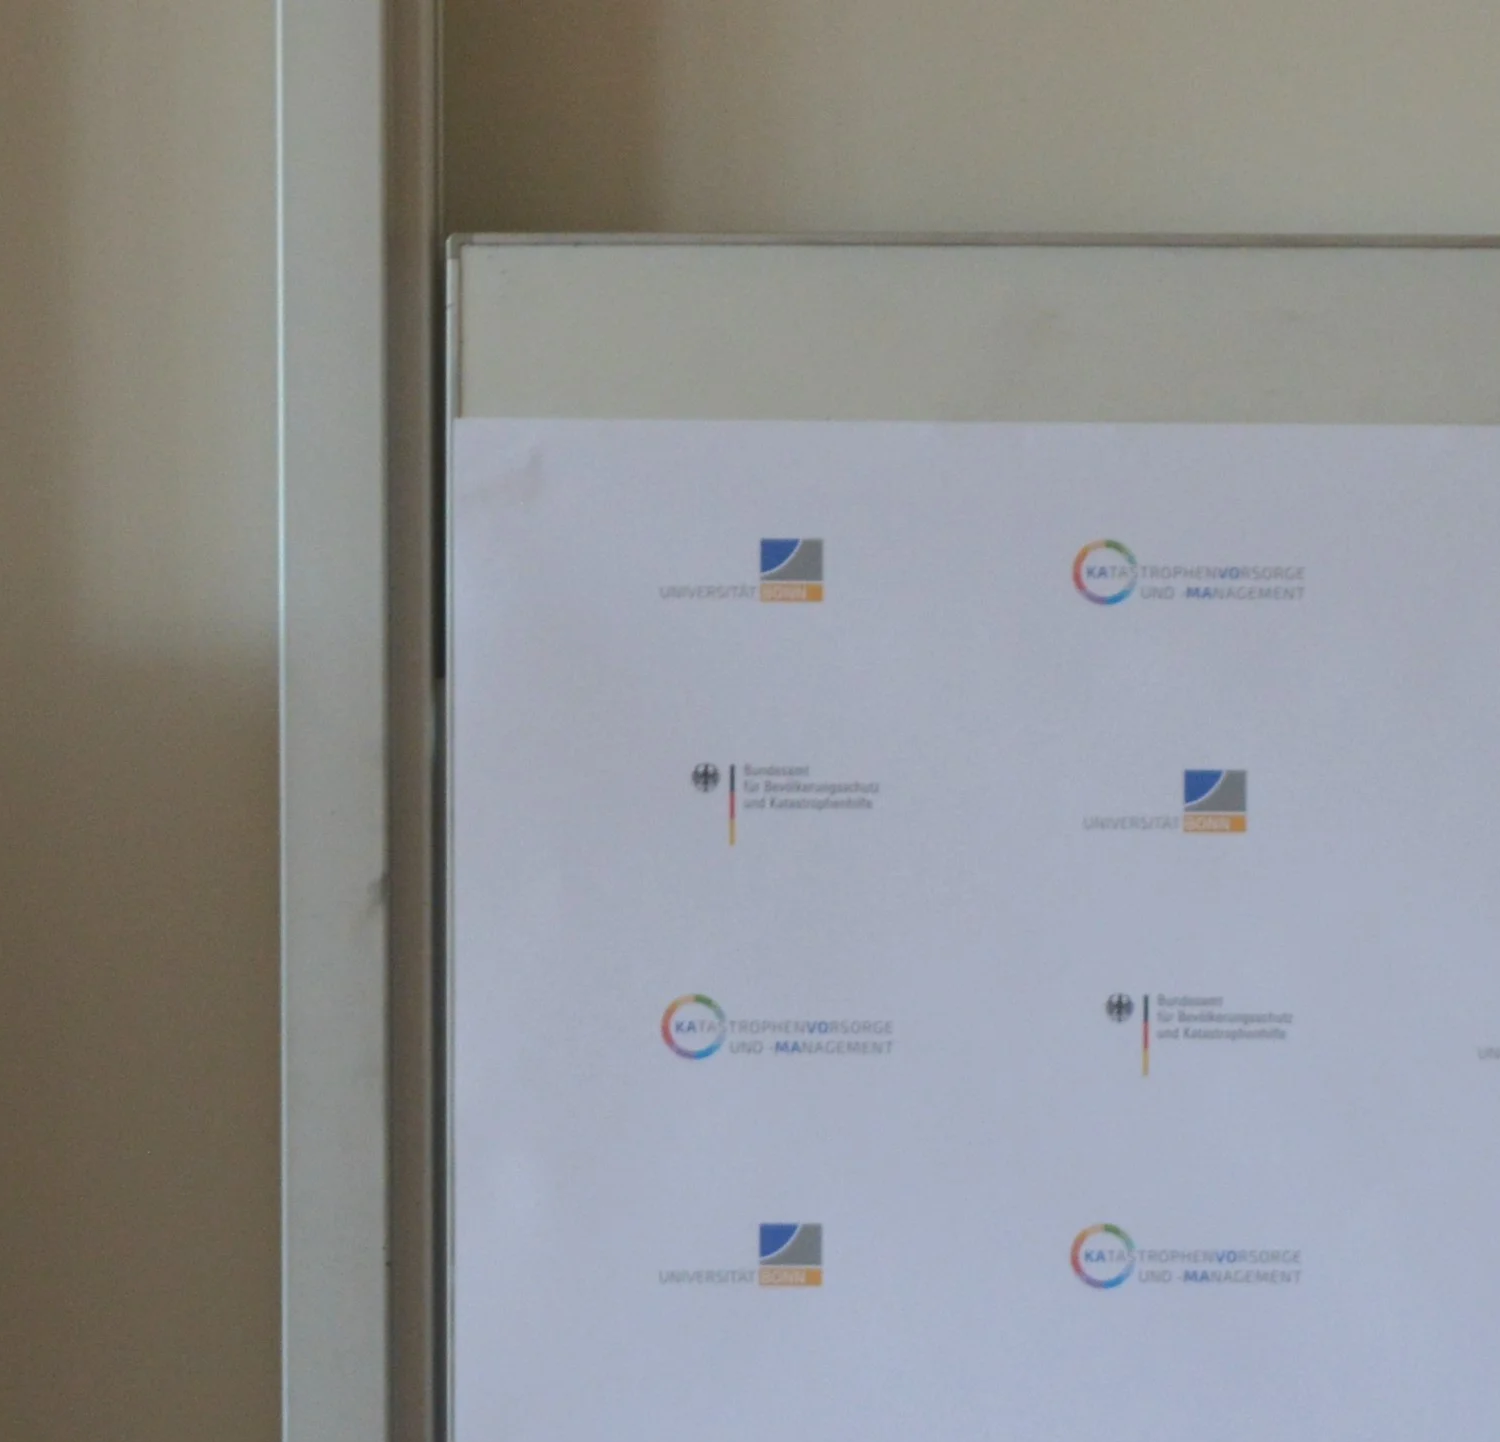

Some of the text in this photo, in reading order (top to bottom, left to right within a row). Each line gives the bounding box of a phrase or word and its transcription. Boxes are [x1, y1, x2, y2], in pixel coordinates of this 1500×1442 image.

[1141, 587, 1174, 601] UND
[743, 797, 765, 809] und
[1157, 1027, 1179, 1039] und
[730, 1041, 763, 1055] UND
[1139, 1270, 1172, 1284] UND
